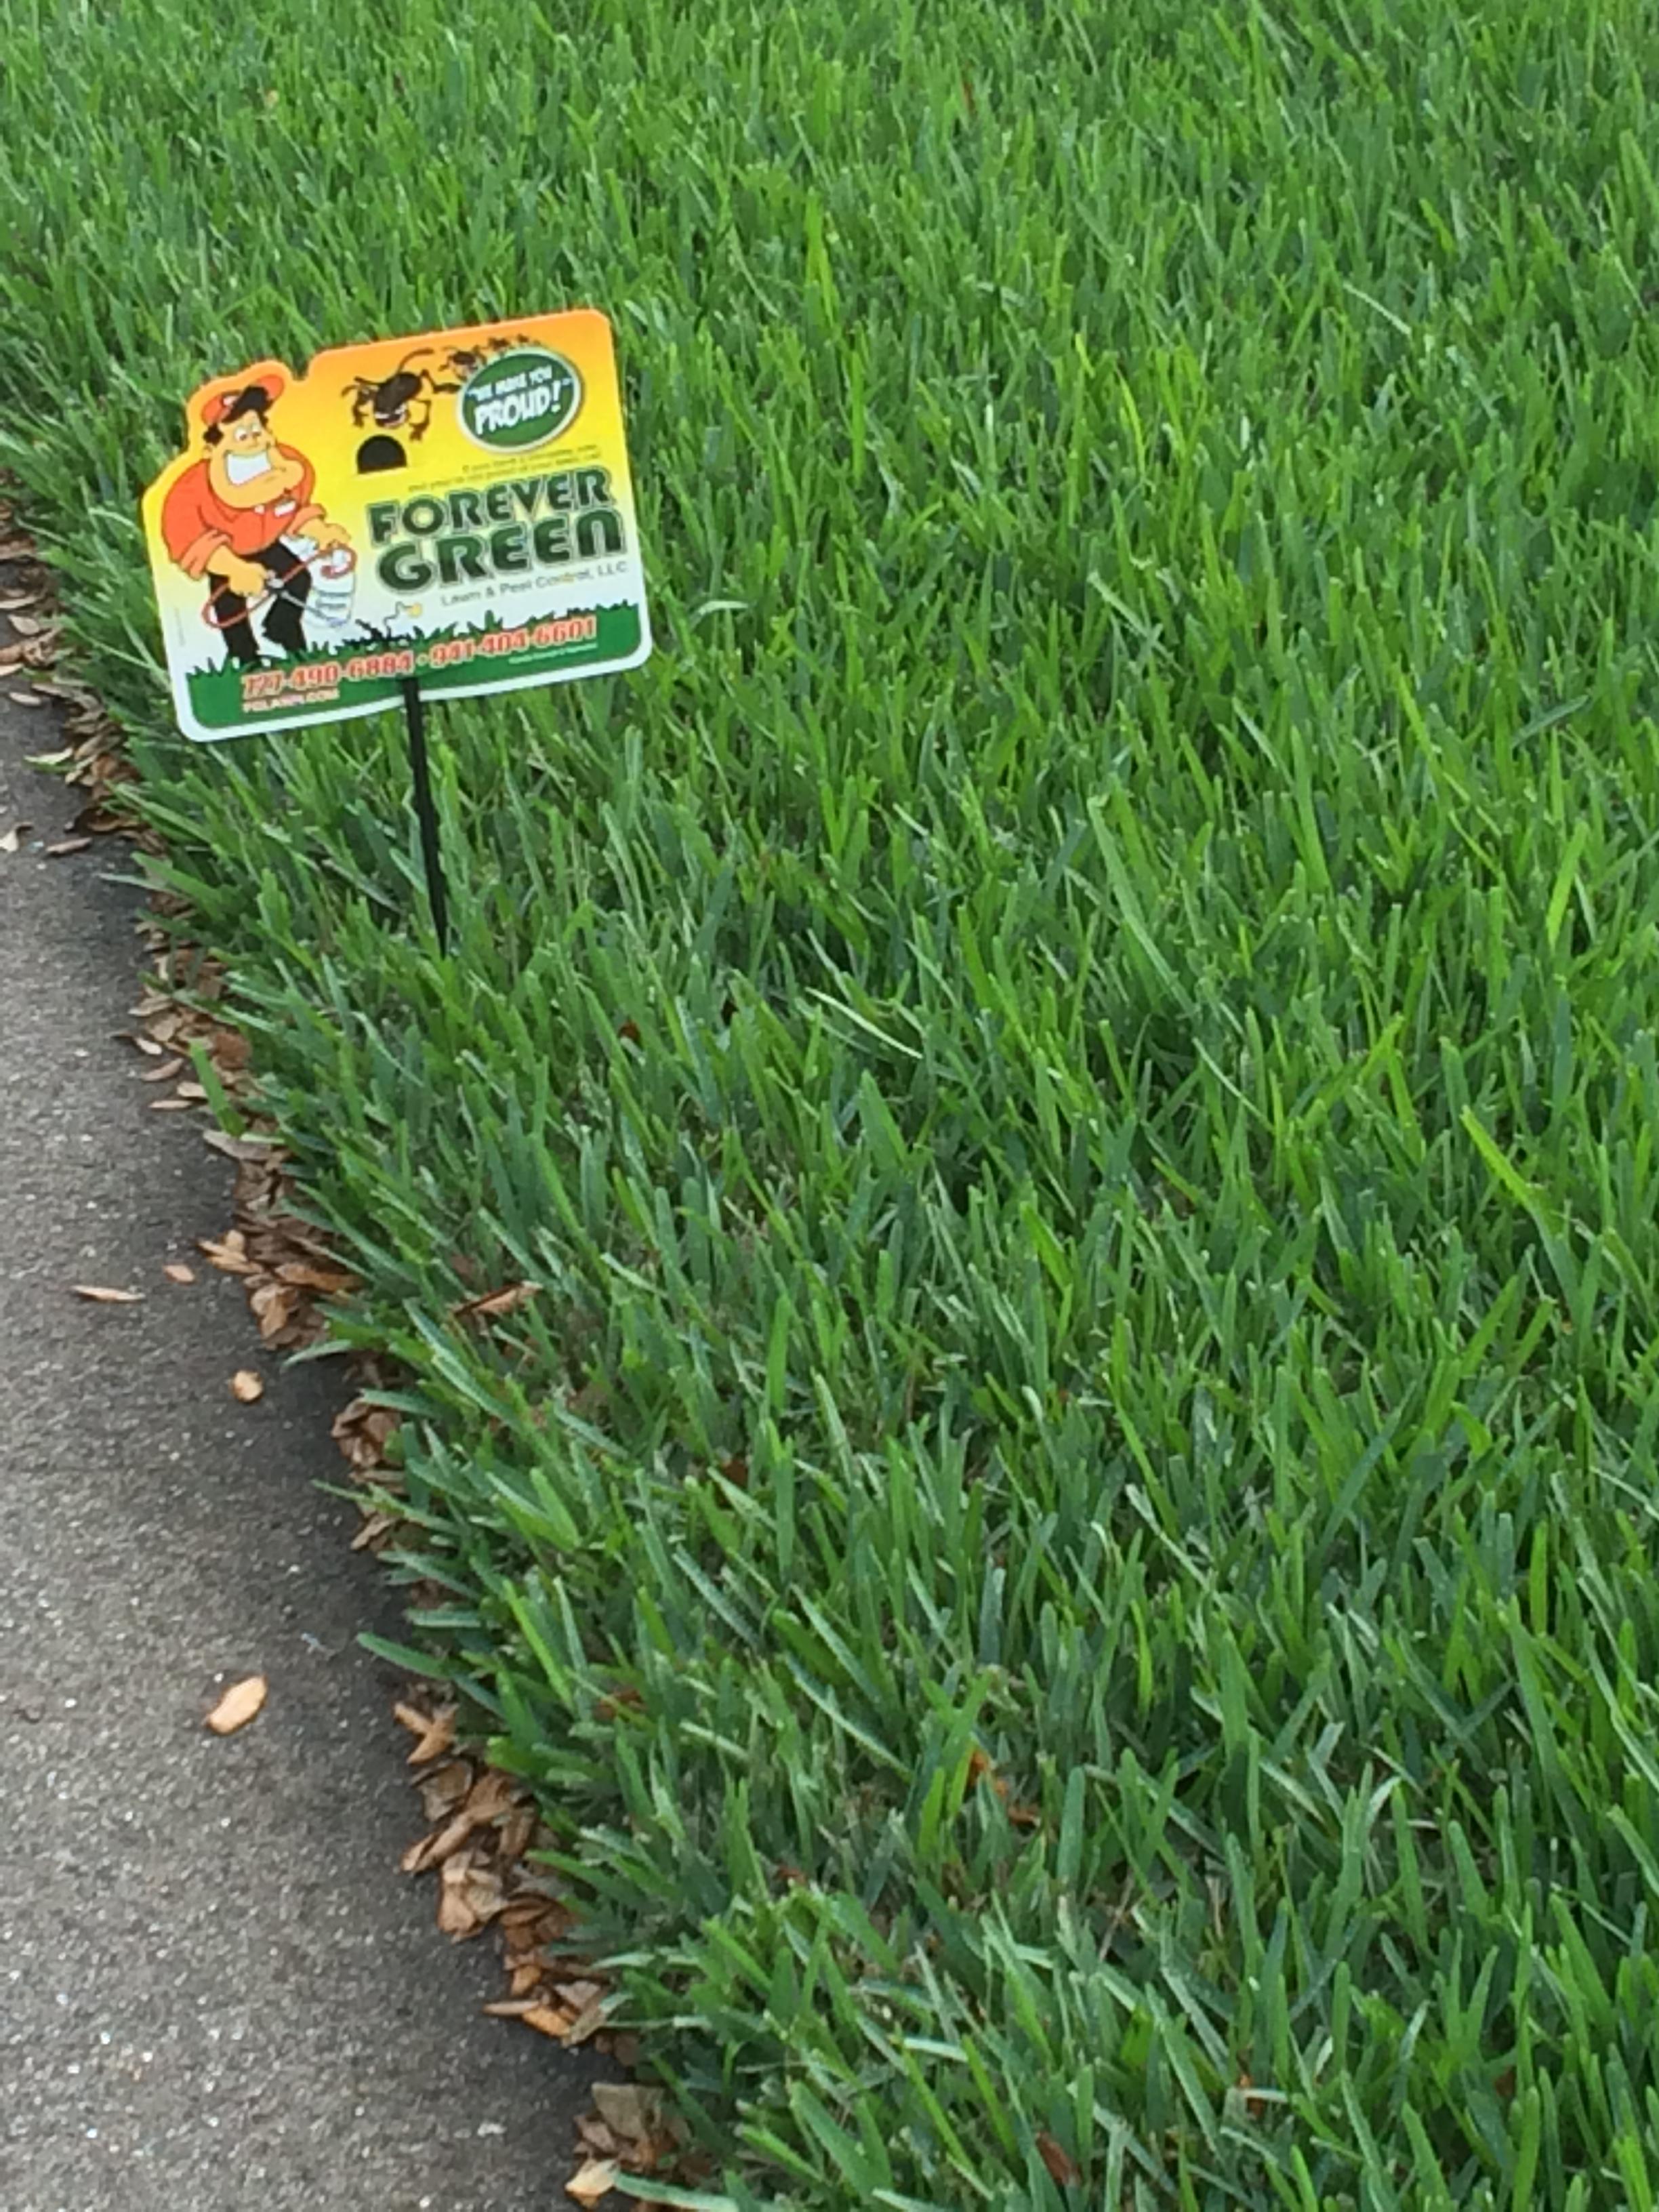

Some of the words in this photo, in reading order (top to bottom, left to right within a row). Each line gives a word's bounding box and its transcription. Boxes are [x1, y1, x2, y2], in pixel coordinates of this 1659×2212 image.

[366, 466, 614, 548] FOREVER
[377, 508, 627, 594] GREEN
[441, 592, 480, 607] Lawn
[485, 586, 495, 597] &
[499, 581, 531, 595] Pest
[598, 560, 628, 576] LLC
